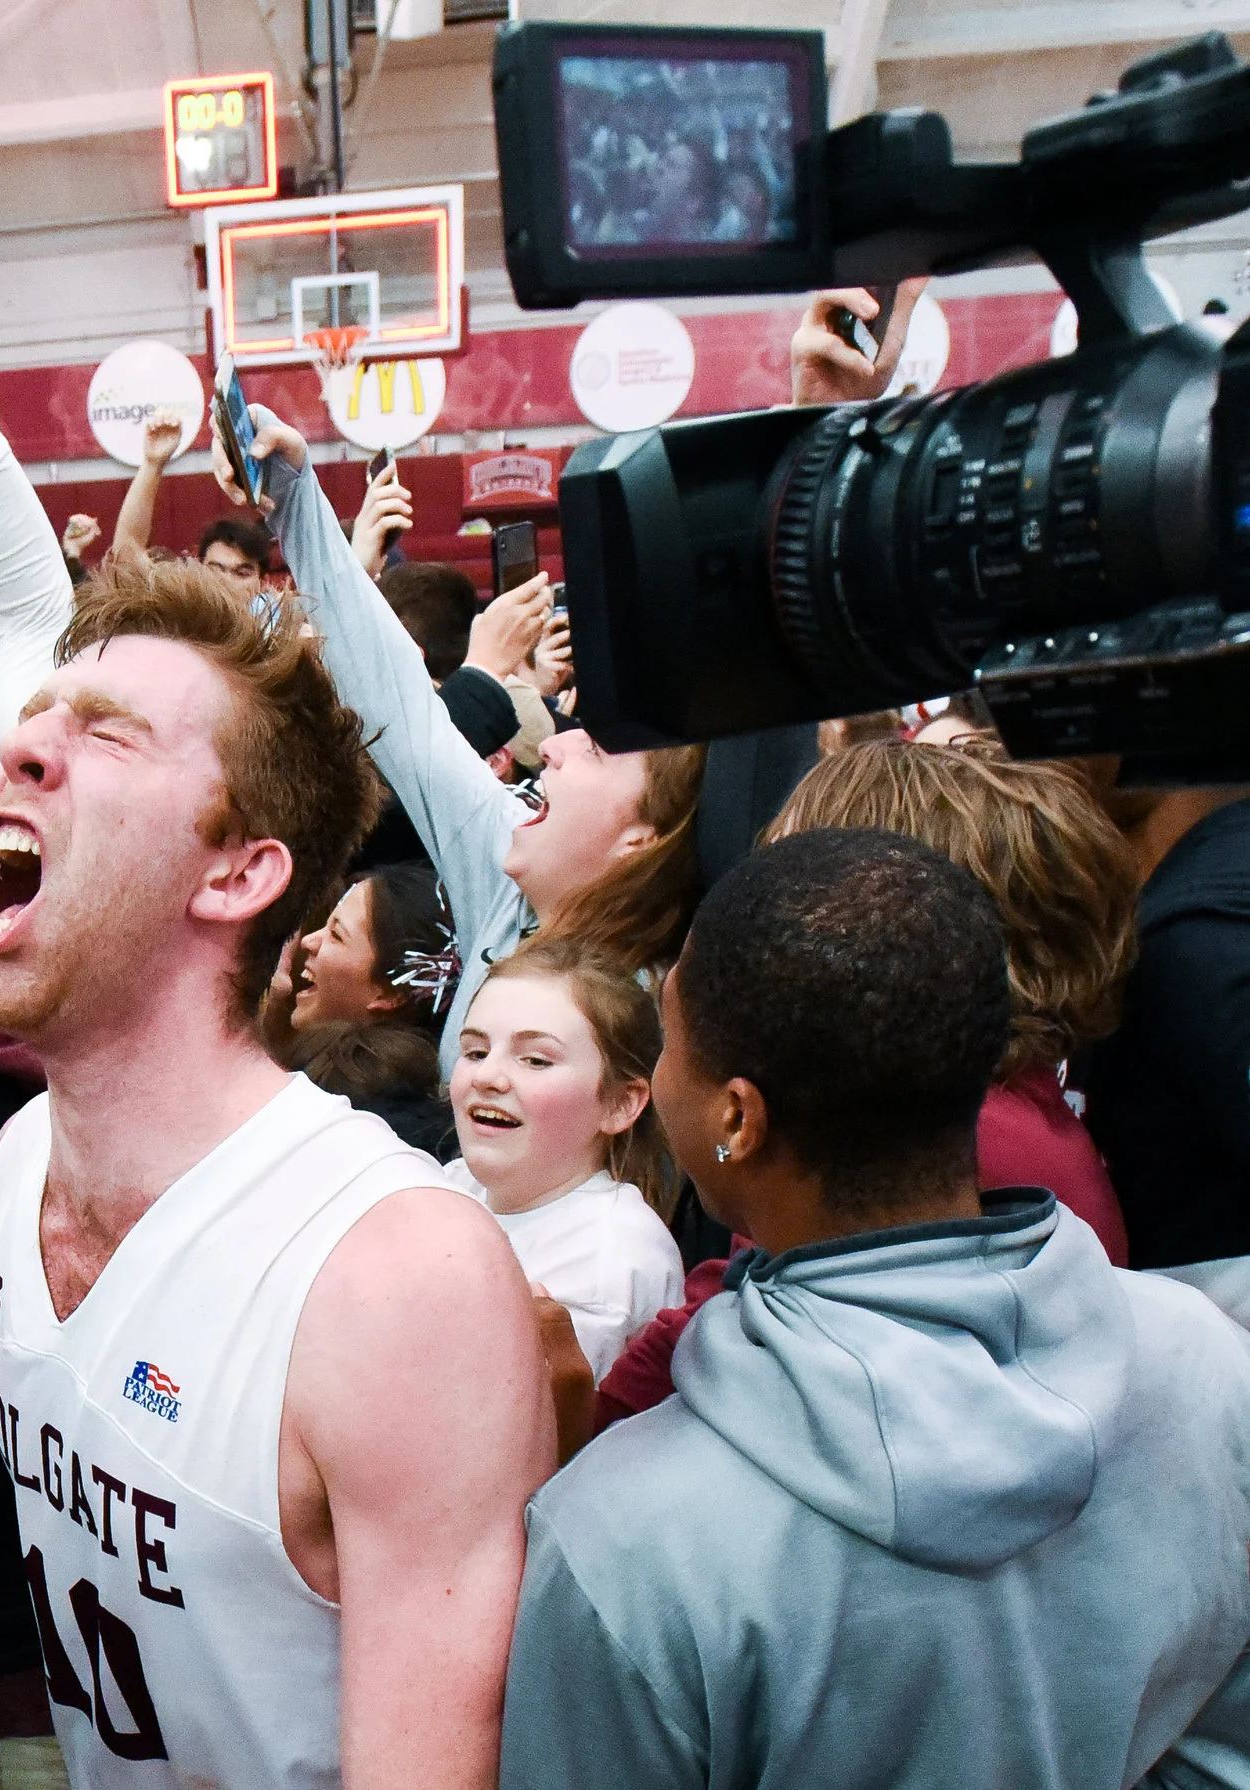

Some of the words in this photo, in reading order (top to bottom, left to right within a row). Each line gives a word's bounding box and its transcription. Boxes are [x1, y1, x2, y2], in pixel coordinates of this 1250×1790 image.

[123, 1388, 178, 1423] LEAGUE
[124, 1376, 182, 1414] PATRIOT
[23, 1544, 170, 1761] 10
